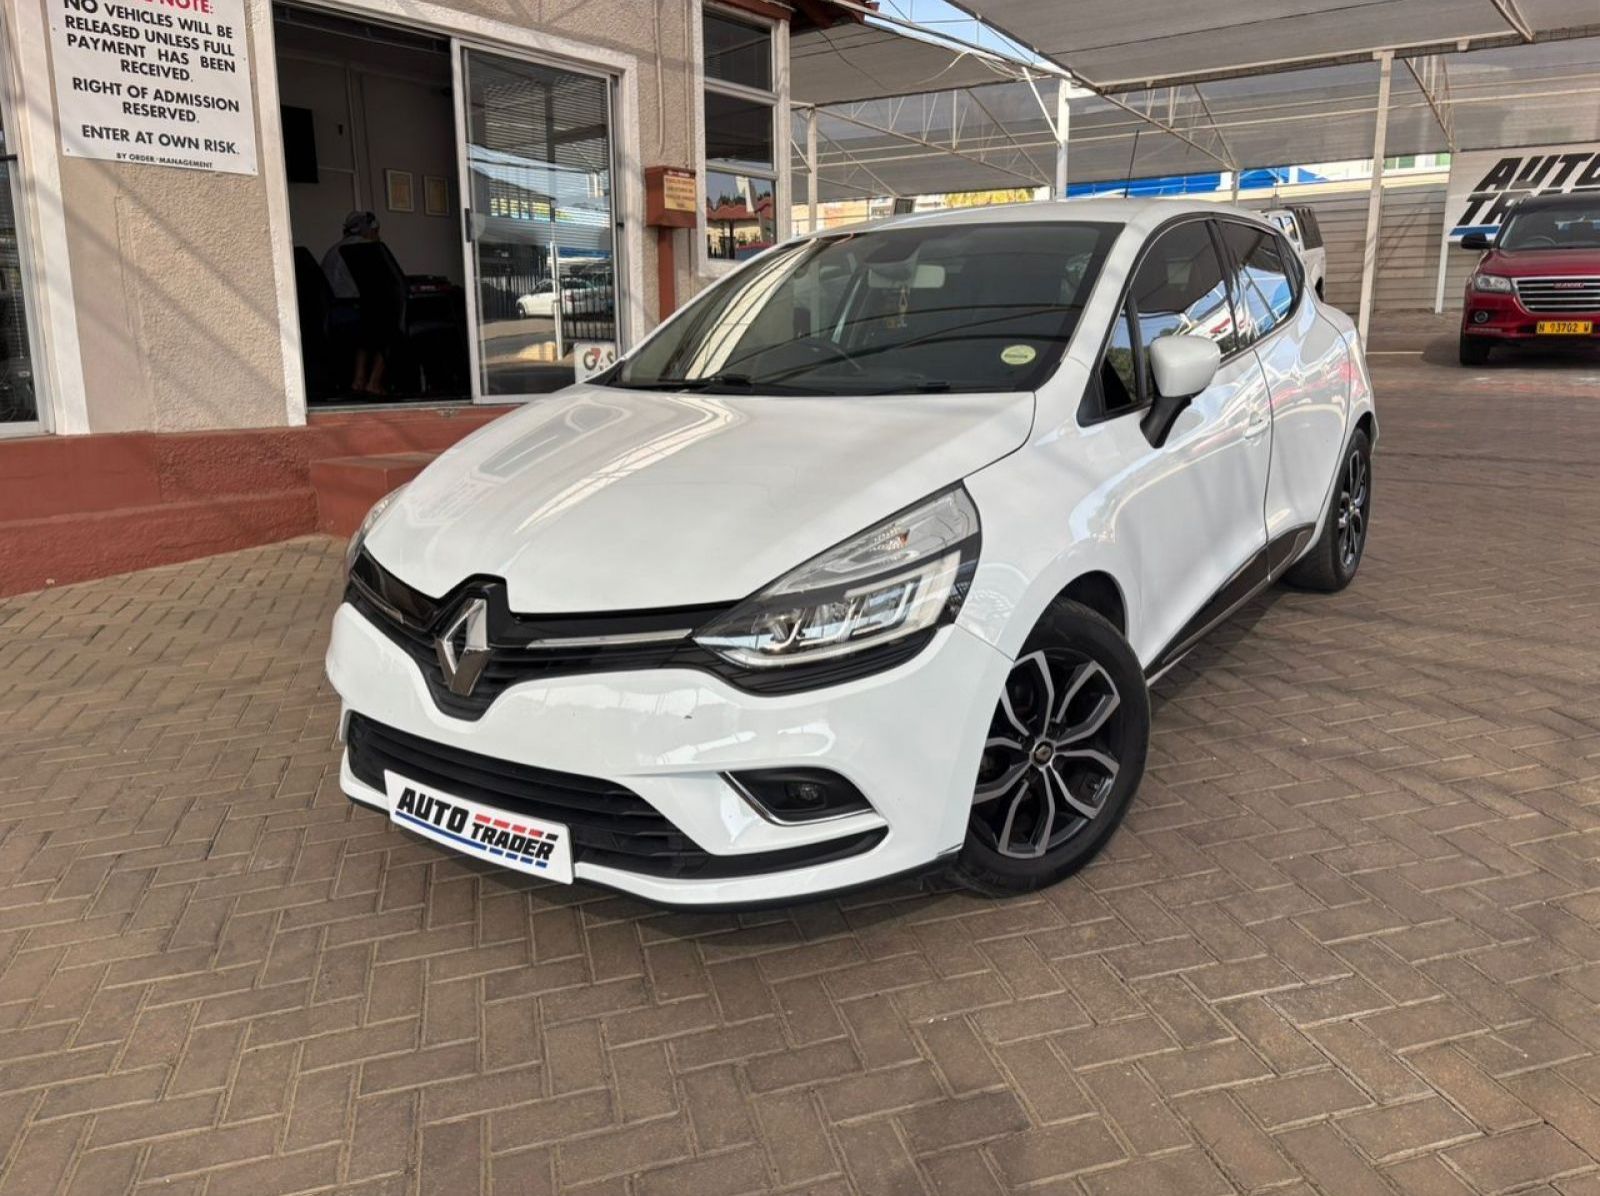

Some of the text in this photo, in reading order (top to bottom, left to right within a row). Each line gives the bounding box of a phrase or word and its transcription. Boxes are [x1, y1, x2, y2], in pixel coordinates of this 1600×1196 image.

[64, 0, 233, 38] NO VEHICLES WILL BE
[65, 15, 235, 56] RELEASED UNLESS FULL
[67, 33, 235, 73] PAYMENT HAS BEEN
[121, 59, 193, 82] RECEIVED.
[72, 77, 239, 112] RIGHT OF ADMISSION
[122, 101, 199, 123] RESERVED.
[82, 124, 240, 154] ENTER AT OWN RISK.
[116, 152, 127, 160] BY
[397, 787, 555, 860] AUTO TRADER
